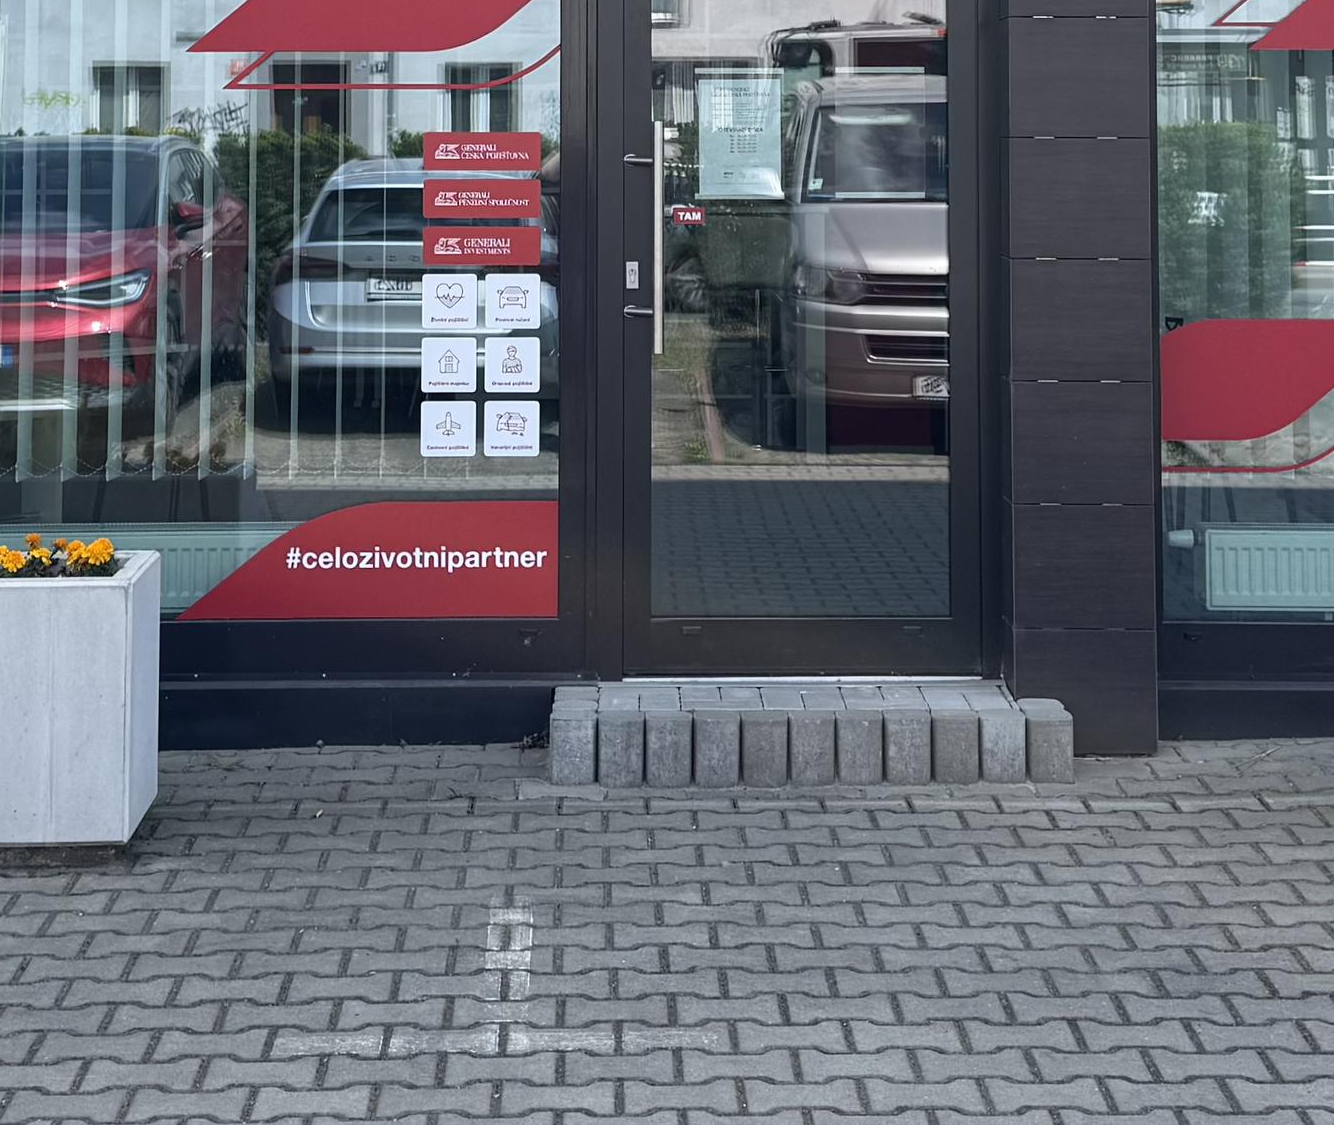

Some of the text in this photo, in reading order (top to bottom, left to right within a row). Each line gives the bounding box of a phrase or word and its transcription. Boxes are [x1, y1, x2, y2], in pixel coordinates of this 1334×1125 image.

[677, 211, 702, 221] TAM
[463, 238, 511, 248] GENERALI
[286, 546, 548, 573] #celozivotnipartner
